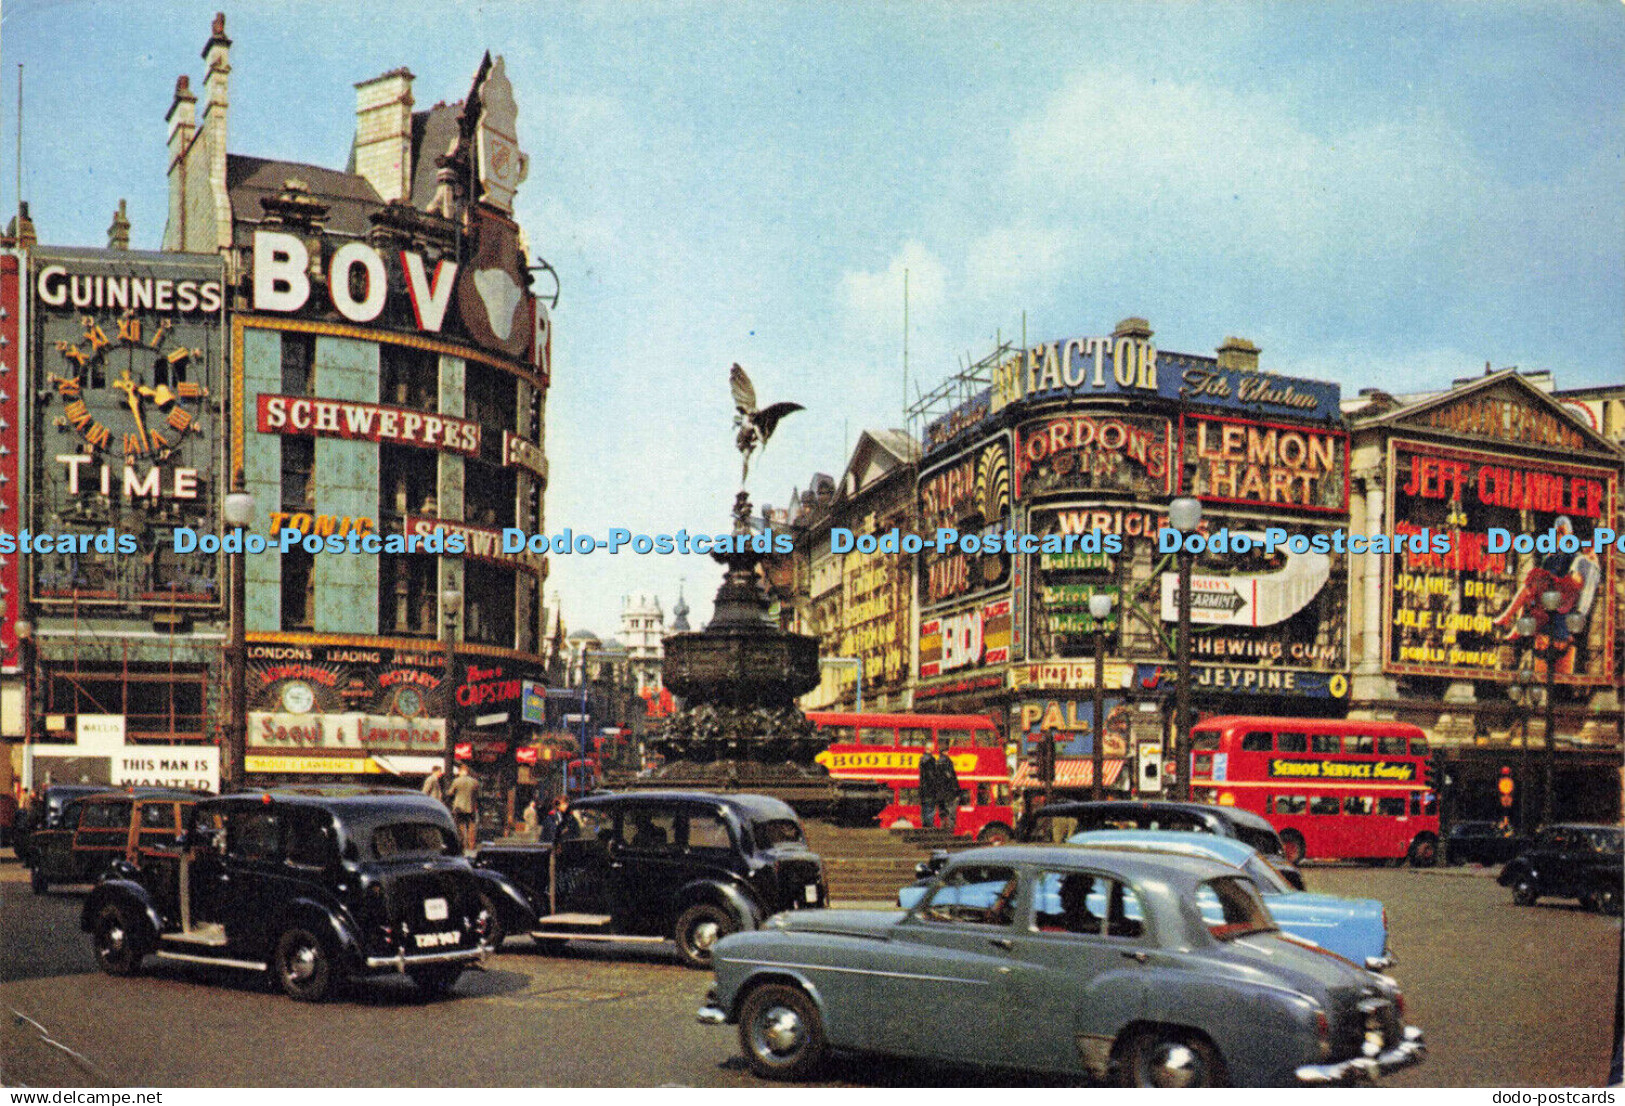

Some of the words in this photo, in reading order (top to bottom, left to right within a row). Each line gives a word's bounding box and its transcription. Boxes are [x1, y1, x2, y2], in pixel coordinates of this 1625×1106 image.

[38, 265, 221, 312] GUINNESS
[1027, 336, 1158, 393] FACTOR
[266, 398, 477, 451] SCHWEPPES
[1197, 420, 1335, 472] LEMON
[56, 454, 197, 499] TIME
[1208, 459, 1320, 505] HART
[1403, 455, 1470, 501] JEFF
[1477, 465, 1603, 519] CHANDLER
[268, 511, 374, 541] TONIC
[1464, 580, 1496, 598] DRU
[247, 647, 313, 660] LONDONS
[326, 650, 381, 664] LEADING
[1291, 643, 1337, 662] GUM
[378, 669, 442, 690] ROTARY
[1199, 669, 1295, 689] JEYPINE
[456, 681, 521, 706] CAPSTAN
[1021, 700, 1089, 731] PAL
[357, 717, 441, 744] Lawrence
[122, 760, 155, 771] THIS
[160, 759, 188, 771] MAN
[194, 760, 209, 772] IS
[832, 754, 914, 768] BOOTH
[1321, 760, 1372, 777] SERVICE
